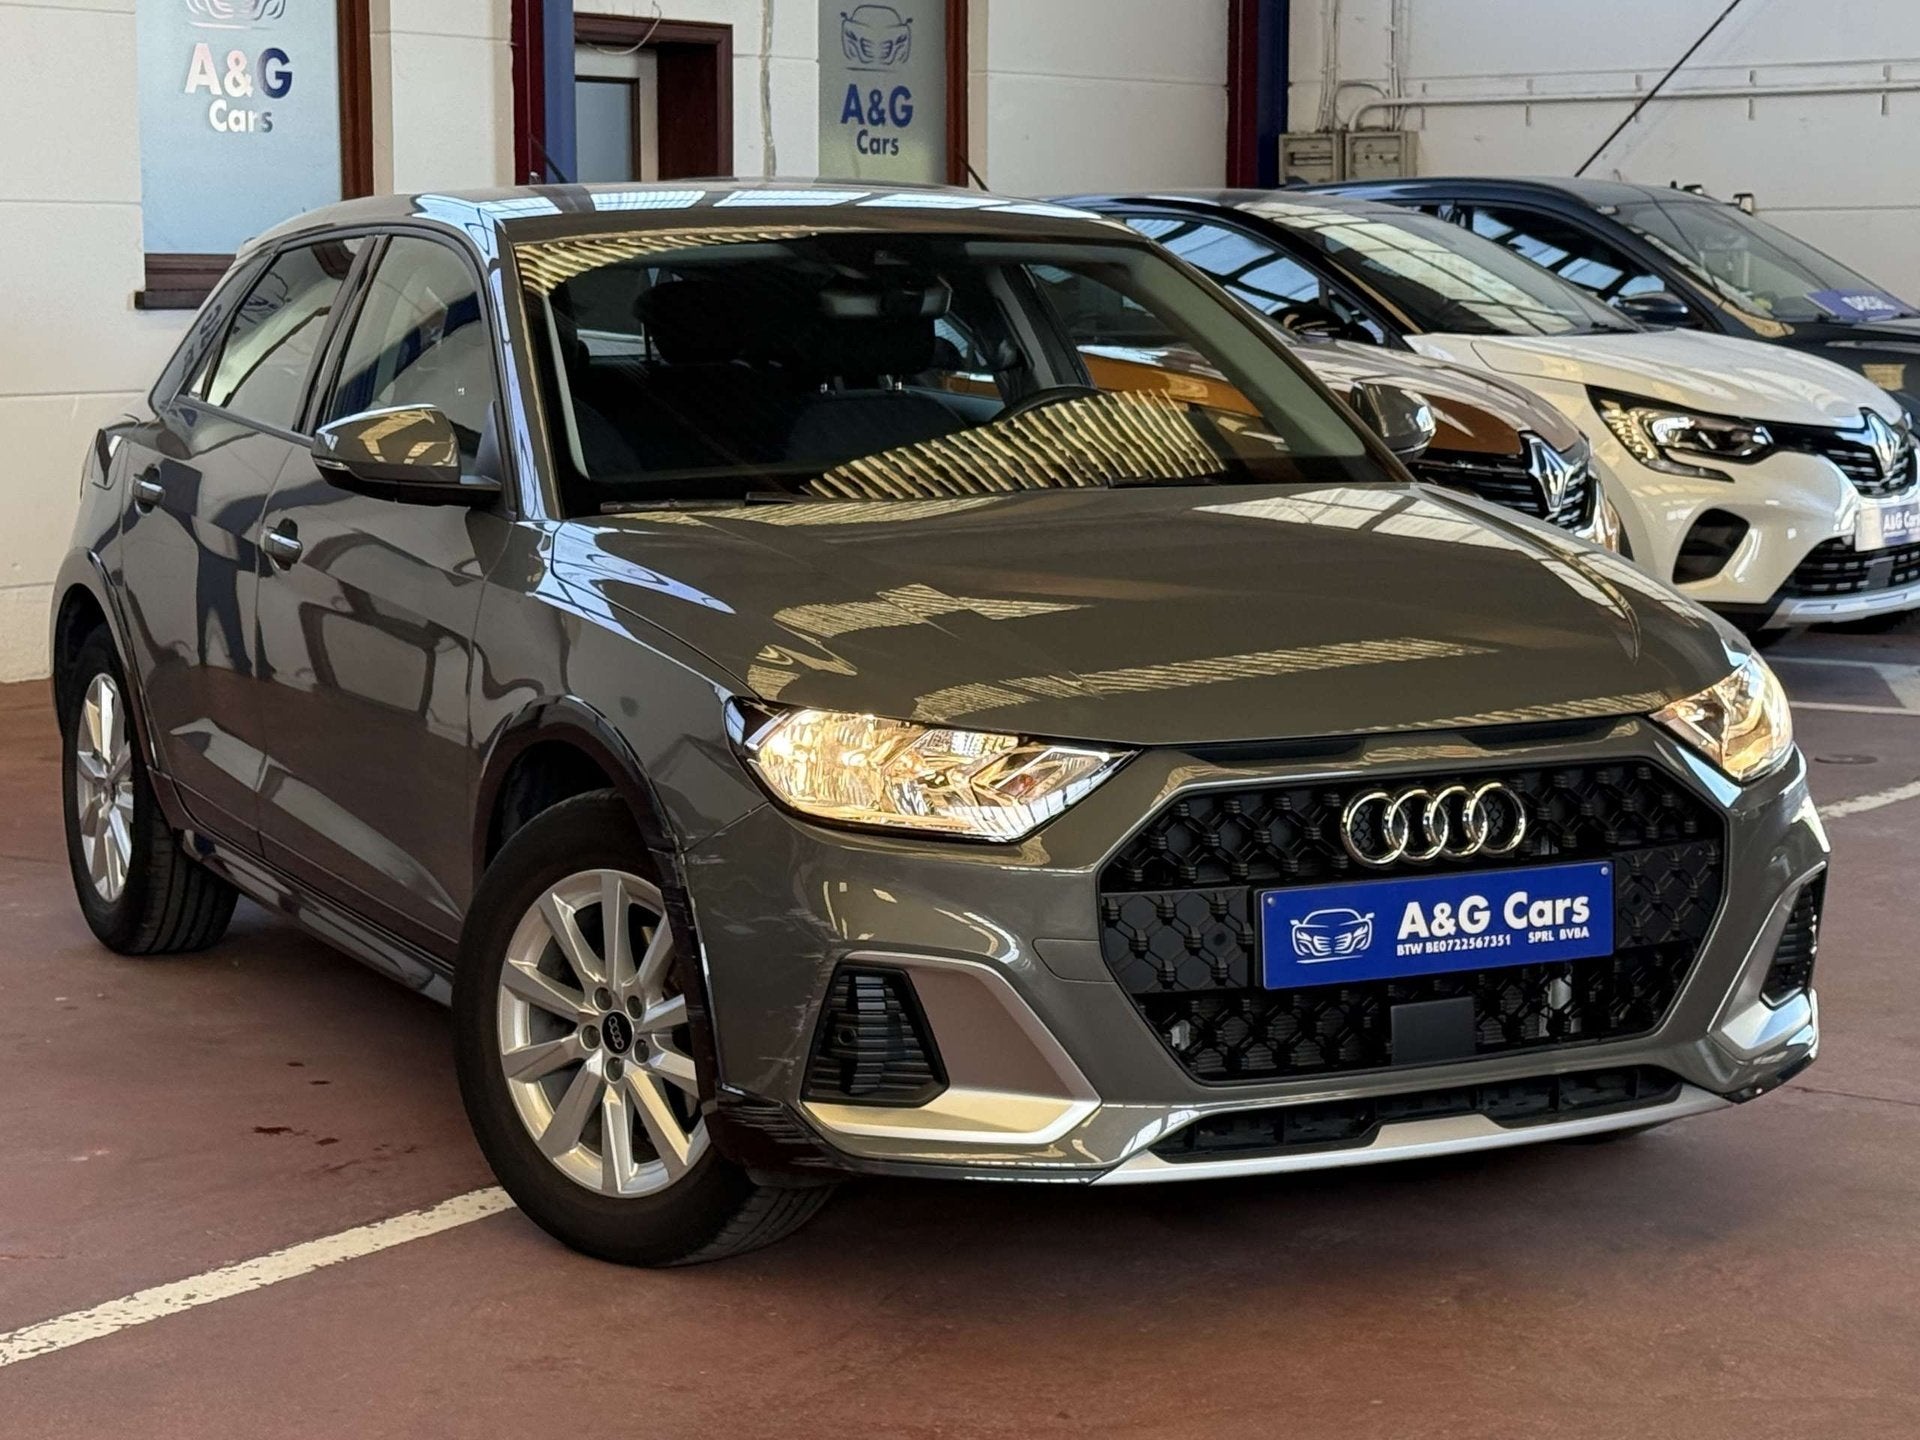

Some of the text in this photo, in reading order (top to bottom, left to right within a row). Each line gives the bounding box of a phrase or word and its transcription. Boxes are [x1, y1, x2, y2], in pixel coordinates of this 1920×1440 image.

[184, 43, 293, 99] A&G
[209, 99, 273, 133] Cars
[840, 84, 914, 128] A&G
[856, 129, 899, 156] Cars
[1397, 891, 1590, 940] A&G Cars
[1396, 926, 1590, 956] BTW BE0722567351 SPRL BVBA
